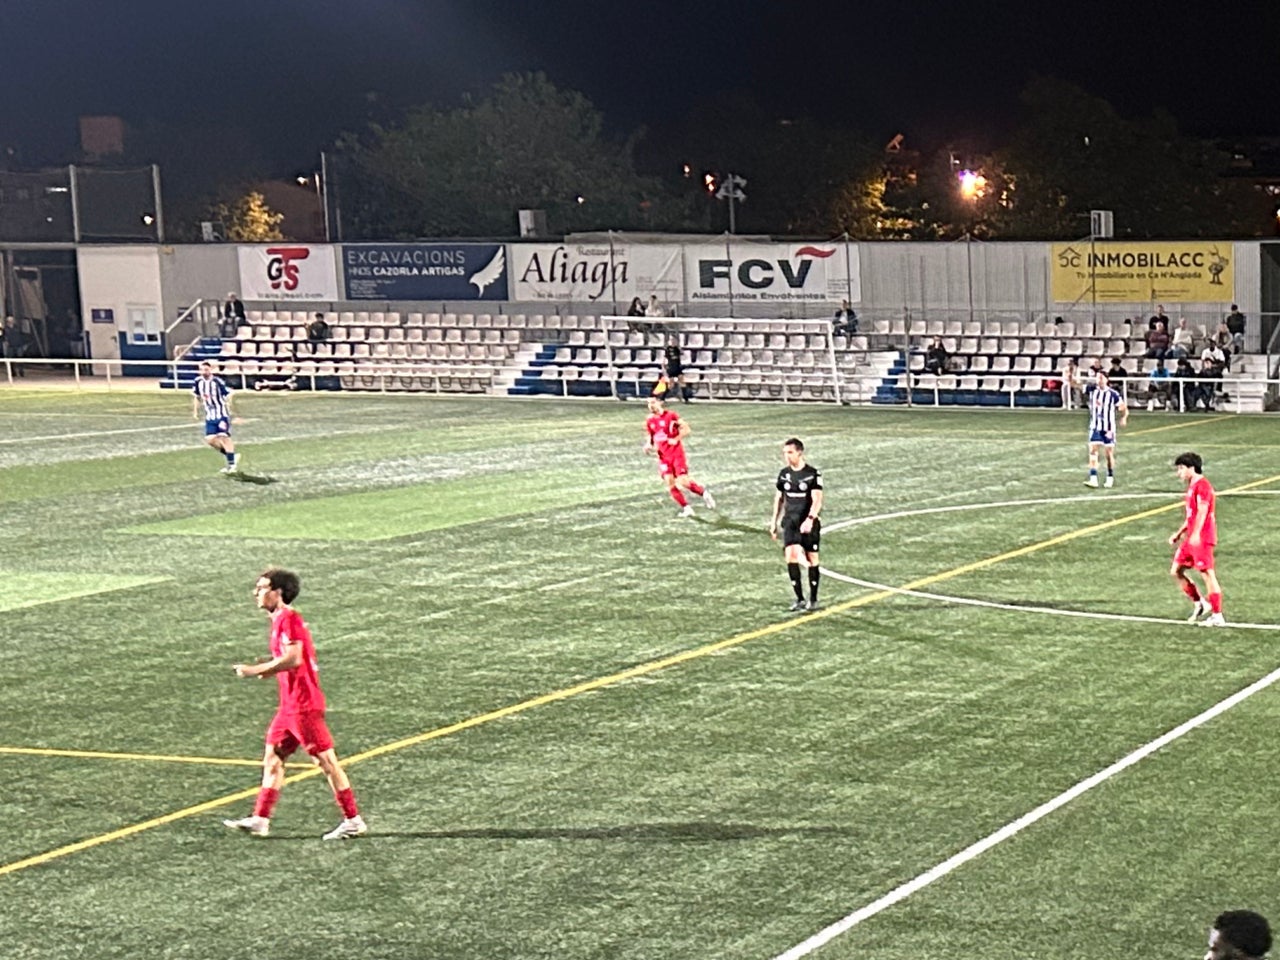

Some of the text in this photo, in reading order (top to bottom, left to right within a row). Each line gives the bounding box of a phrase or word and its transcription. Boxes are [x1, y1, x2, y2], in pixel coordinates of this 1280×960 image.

[347, 250, 465, 264] EXCAVACIONS
[1087, 252, 1204, 267] INMOBILACC
[373, 267, 420, 276] CAZORLA
[421, 266, 466, 276] ARTIGAS
[519, 246, 629, 299] Aliaga
[699, 259, 813, 289] FCV
